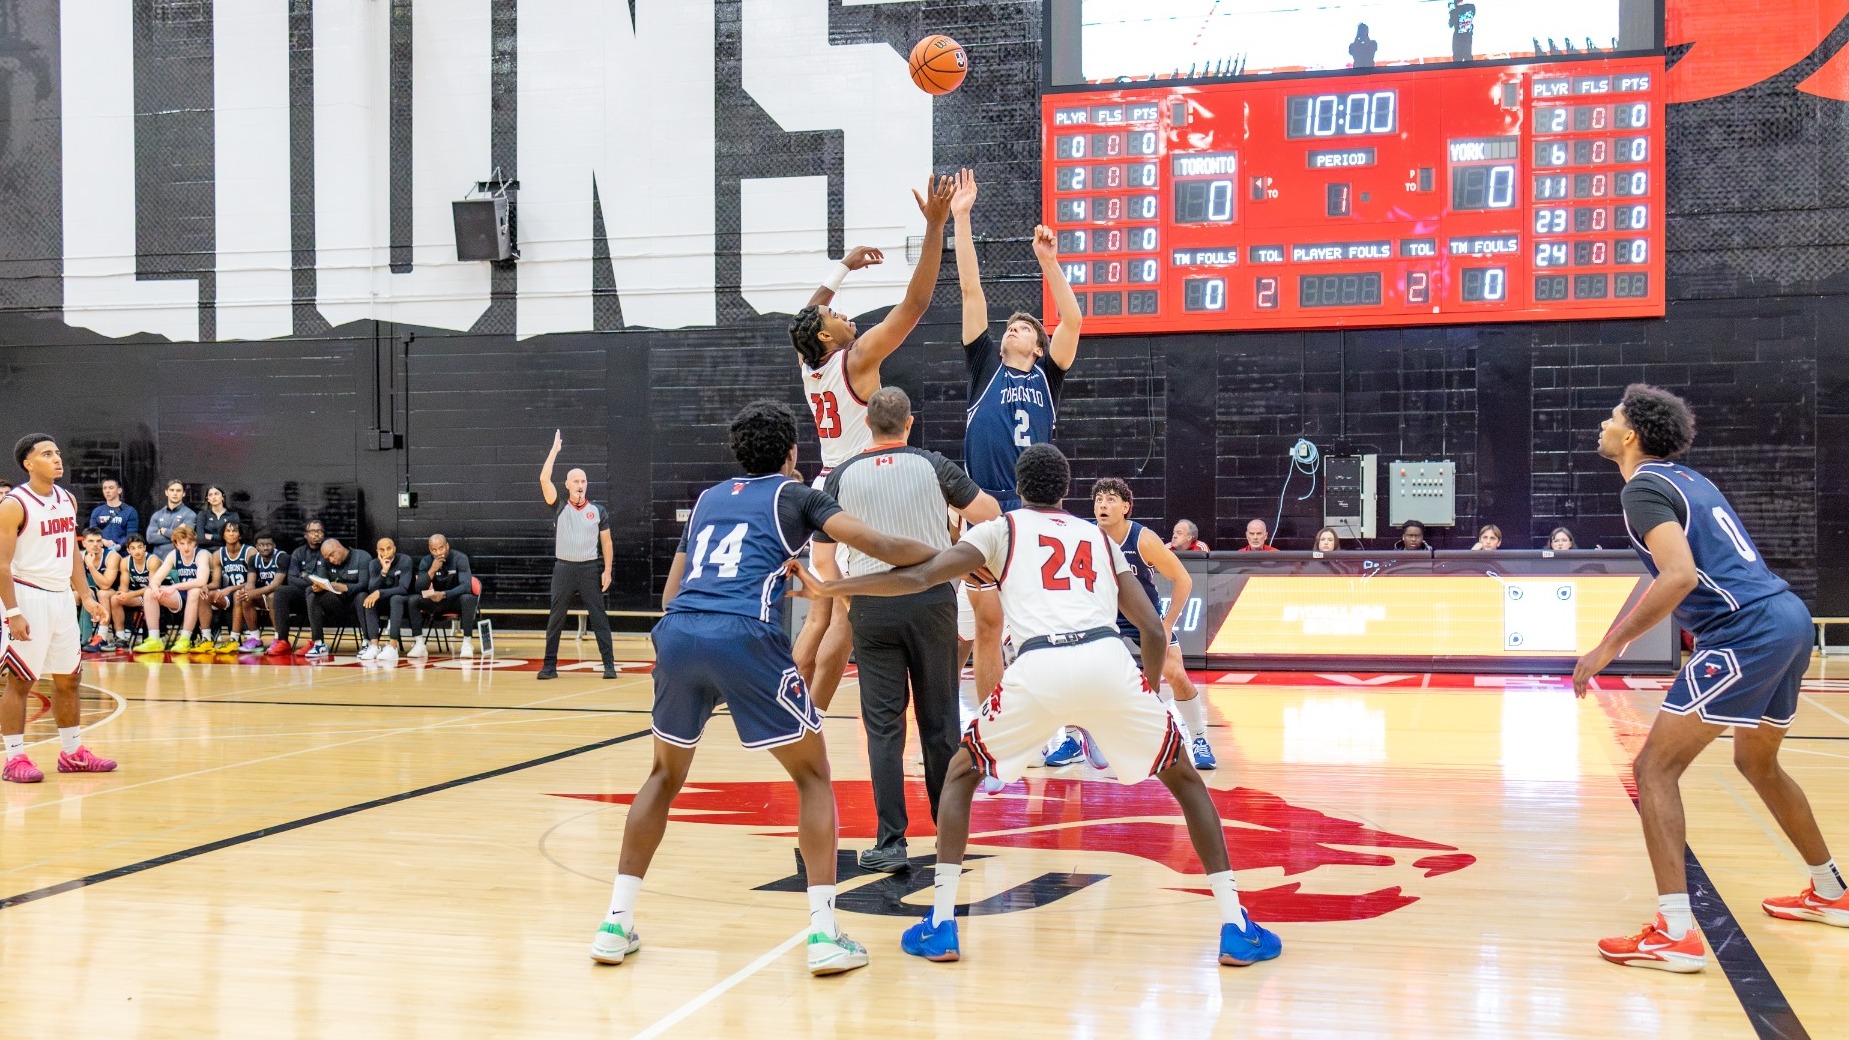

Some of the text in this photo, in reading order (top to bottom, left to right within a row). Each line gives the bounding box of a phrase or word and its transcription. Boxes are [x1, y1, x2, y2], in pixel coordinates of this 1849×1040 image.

[1534, 78, 1648, 96] PLYR FLS PTS
[1056, 108, 1158, 124] PLYR FLS PTS
[1306, 92, 1395, 136] 10:00
[1552, 104, 1646, 131] 2 0 0
[1072, 132, 1156, 157] 0 0 0
[1450, 142, 1484, 162] YORK
[1592, 141, 1605, 162] 0
[1631, 138, 1646, 161] 0
[1180, 156, 1235, 176] TORONTO
[1317, 153, 1366, 167] PERIOD
[1072, 164, 1156, 189] 2 0 0
[1267, 178, 1272, 186] P
[1410, 170, 1416, 178] P
[1544, 172, 1646, 197] 11 0 0
[1267, 189, 1279, 198] TO
[1404, 182, 1416, 192] TO
[1488, 166, 1514, 208] 0
[1072, 196, 1156, 219] 4 0 0
[1208, 180, 1232, 220] 0
[1342, 187, 1348, 212] 1
[1536, 206, 1646, 232] 23 0 0
[1074, 228, 1156, 250] 7 0 0
[1410, 244, 1434, 256] TOL
[1450, 240, 1517, 254] TM FOULS
[1174, 252, 1236, 265] TM FOULS
[1258, 250, 1283, 262] TOL
[1294, 246, 1390, 260] PLAYER FOULS
[1536, 240, 1646, 266] 24 0 0
[1066, 260, 1156, 283] 14 0 0
[1206, 280, 1224, 310] 0
[1258, 279, 1276, 307] 2
[1409, 272, 1426, 301] 2
[1484, 269, 1503, 300] 0
[1000, 385, 1044, 408] TORONTO
[811, 390, 842, 438] 23
[1014, 409, 1032, 447] 2
[40, 516, 75, 537] LIONS
[1712, 506, 1757, 562] 0
[56, 536, 67, 558] 11
[686, 522, 750, 584] 14
[1038, 534, 1098, 593] 24
